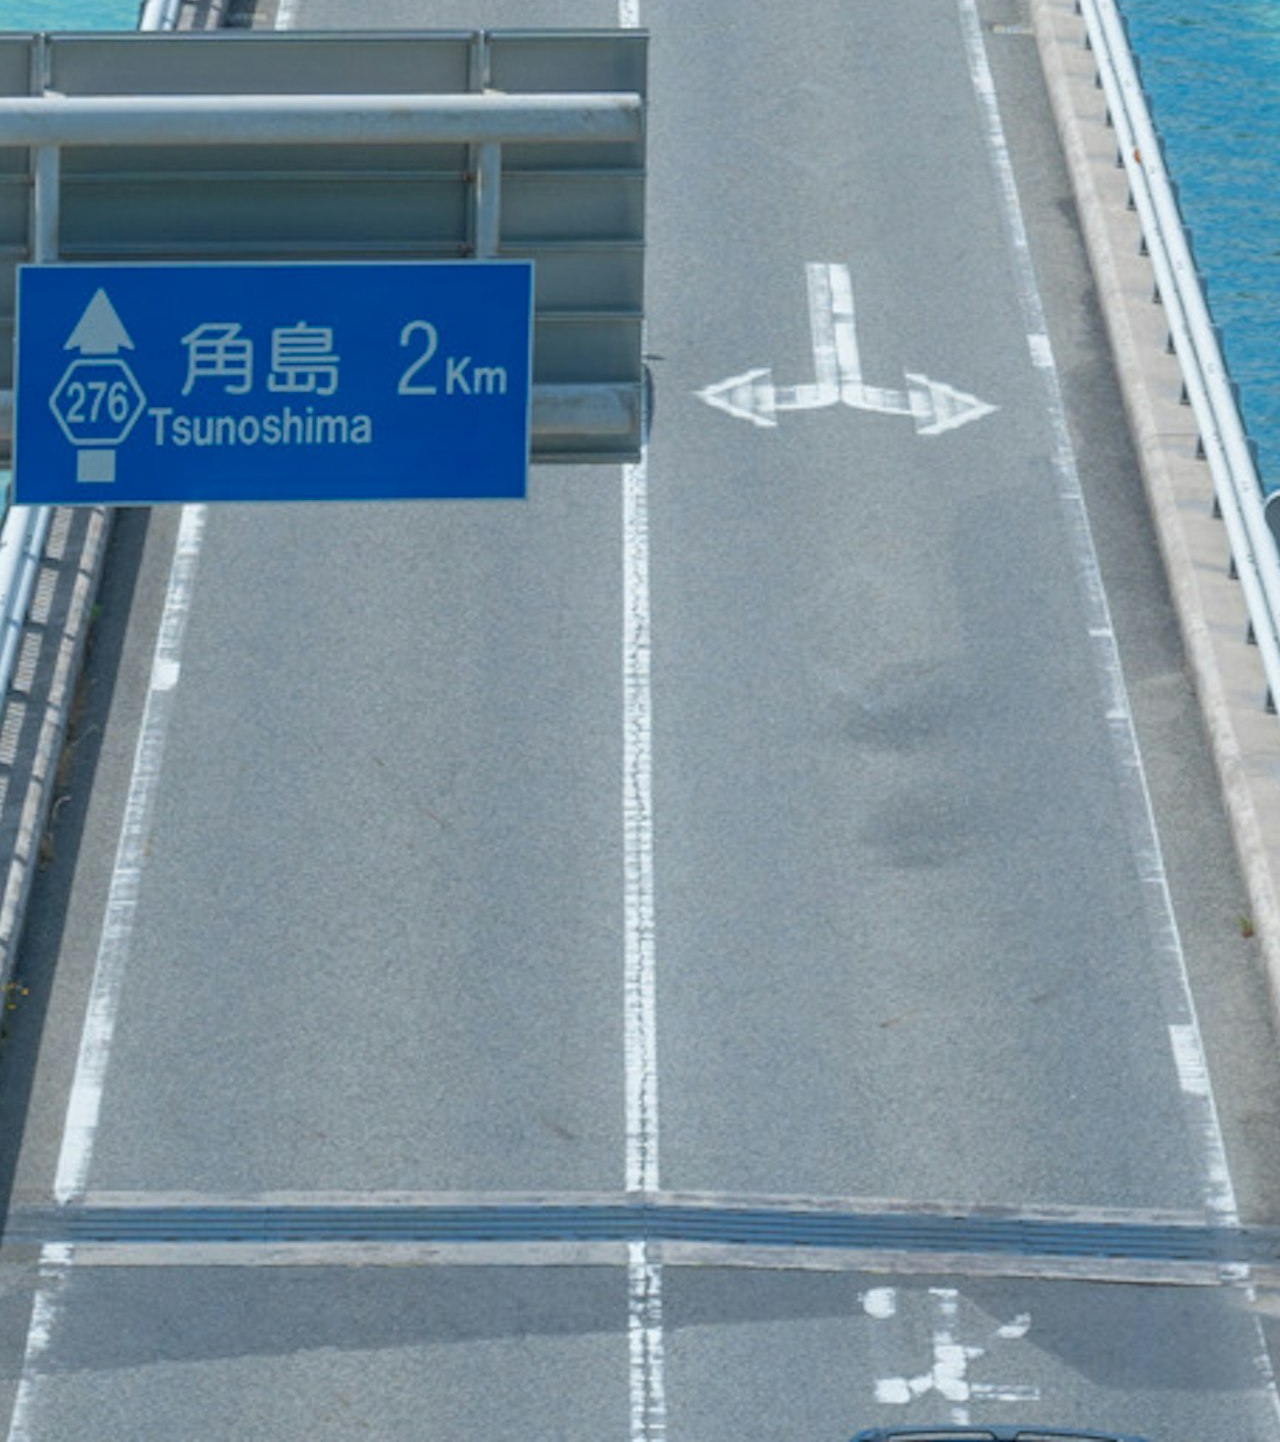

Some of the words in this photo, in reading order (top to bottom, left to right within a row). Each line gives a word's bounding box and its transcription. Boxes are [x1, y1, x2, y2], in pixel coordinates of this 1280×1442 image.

[181, 321, 340, 396] 角島
[66, 381, 129, 423] 276
[148, 406, 372, 446] Tsunoshima
